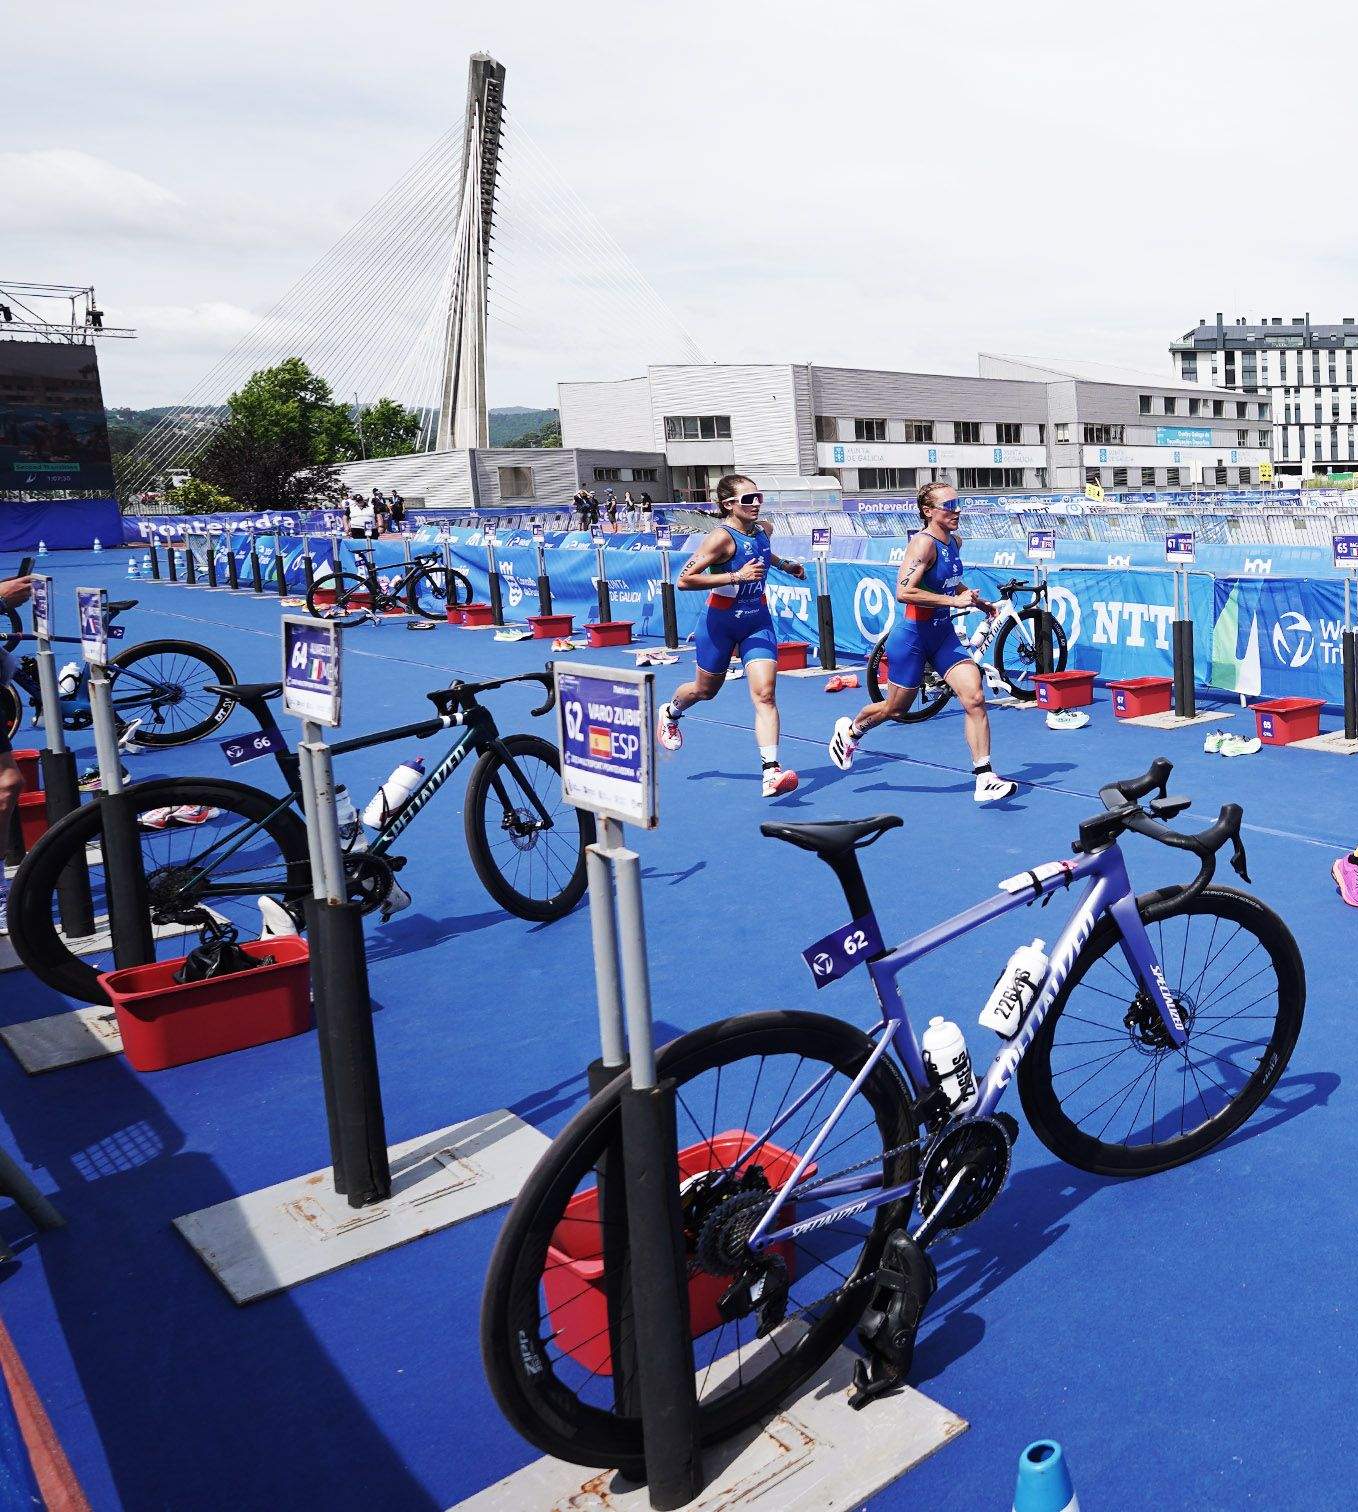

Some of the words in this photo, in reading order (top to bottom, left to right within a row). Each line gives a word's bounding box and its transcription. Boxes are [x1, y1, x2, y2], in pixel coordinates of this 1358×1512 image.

[858, 502, 918, 514] Pontevedra
[138, 513, 294, 538] Pontevedra
[1337, 543, 1348, 553] 65
[741, 581, 763, 595] ITA
[1092, 602, 1175, 650] NTT
[291, 641, 308, 669] 64
[564, 701, 584, 742] 62
[588, 703, 613, 723] VARO
[253, 736, 271, 750] 66
[611, 732, 639, 760] ESP
[382, 745, 467, 842] SPECIALIZED
[843, 930, 869, 955] 62
[998, 906, 1095, 1089] SPECIALIZED
[1150, 964, 1185, 1031] SPECIALIZED
[792, 1200, 868, 1238] SPECIALIZED
